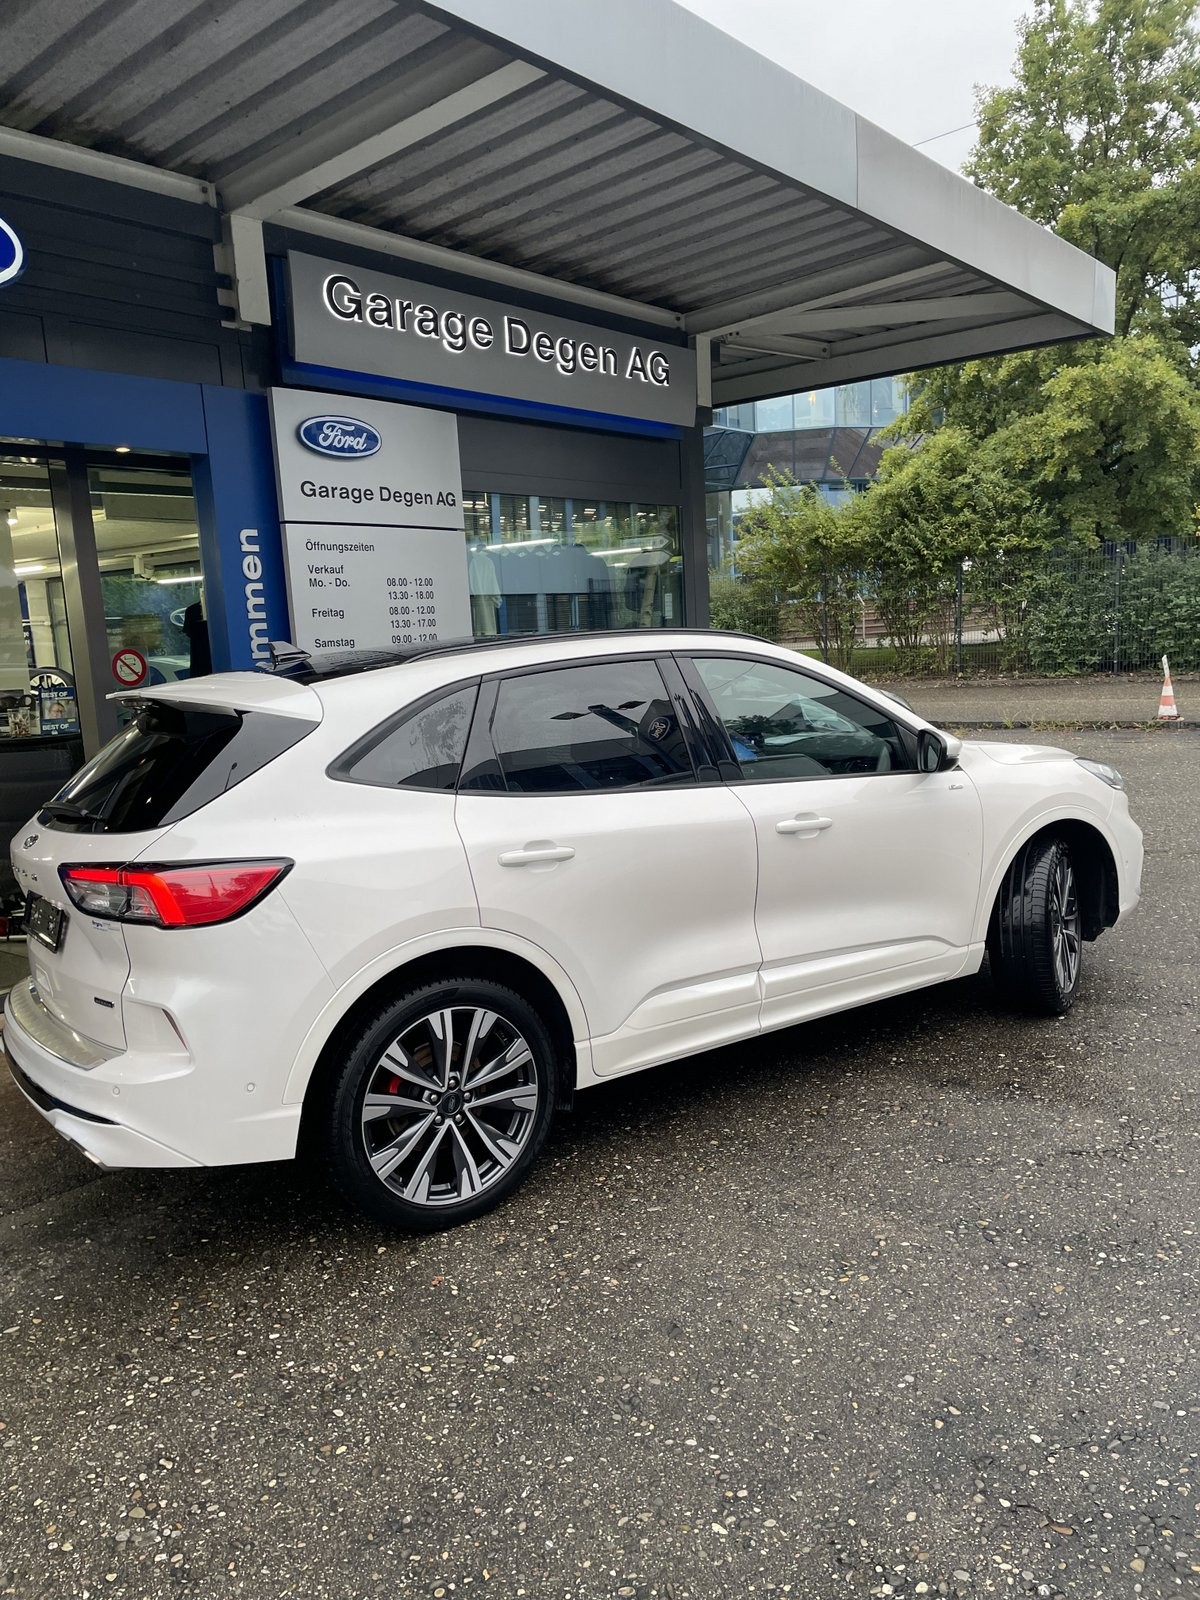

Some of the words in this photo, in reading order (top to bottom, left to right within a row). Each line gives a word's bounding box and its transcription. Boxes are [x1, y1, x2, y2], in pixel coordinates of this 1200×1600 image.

[322, 273, 494, 354] Garage
[503, 315, 619, 376] Degen
[625, 346, 671, 387] AG
[318, 422, 368, 451] Ford
[300, 480, 374, 504] Garage
[379, 486, 433, 507] Degen
[436, 491, 457, 507] AG
[305, 539, 375, 553] Öffnungszeiten
[307, 564, 344, 574] Verkauf
[308, 578, 327, 588] Mo.
[334, 577, 351, 588] Do.
[386, 578, 408, 587] 08.00
[414, 578, 433, 587] 12.00
[239, 528, 272, 668] mmen
[388, 591, 409, 600] 13.30
[415, 591, 434, 600] 18.00
[311, 608, 345, 619] Freitag
[389, 606, 410, 615] 08.00
[416, 606, 435, 615] 12.00
[391, 619, 411, 629] 13.30
[418, 619, 436, 628] 17.00
[314, 638, 355, 649] Samstag
[391, 634, 412, 644] 09.00
[419, 633, 438, 641] 1200
